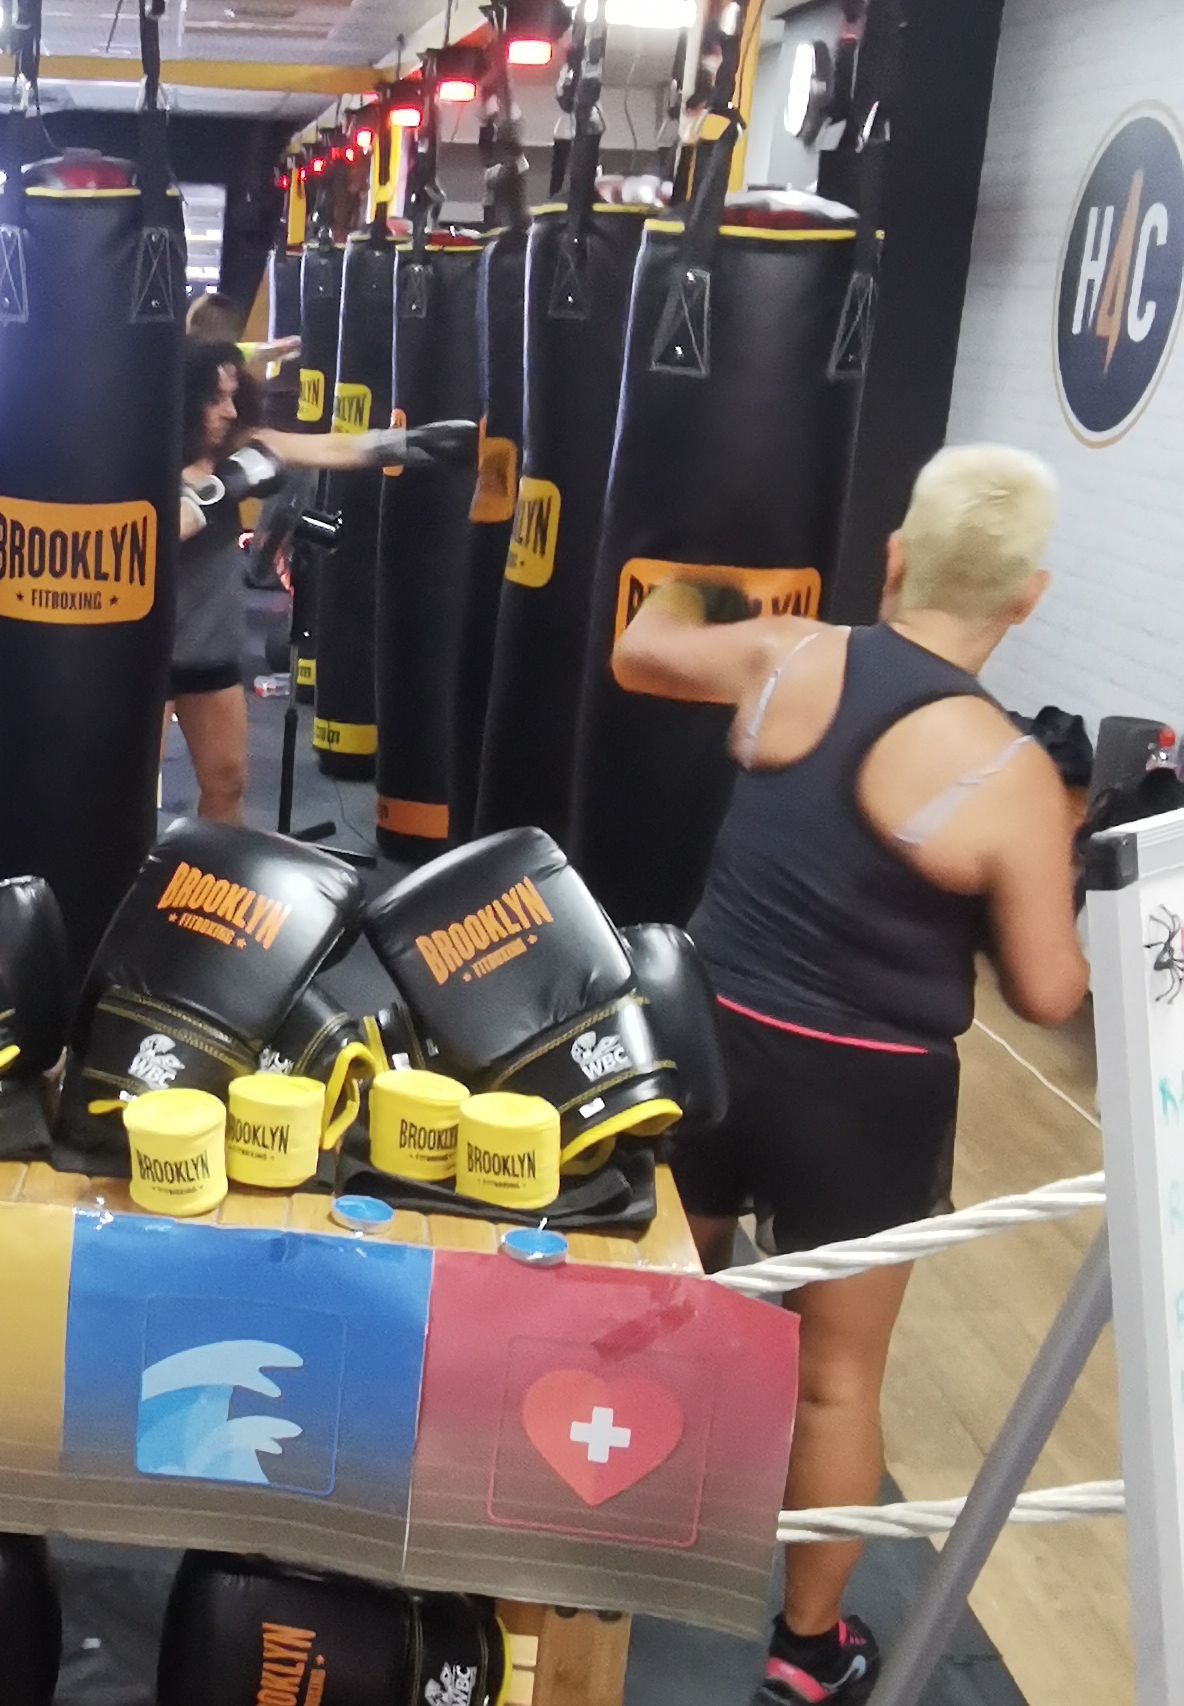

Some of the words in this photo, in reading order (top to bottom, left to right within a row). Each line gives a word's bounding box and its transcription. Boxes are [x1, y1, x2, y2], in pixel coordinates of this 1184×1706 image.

[1071, 169, 1169, 374] H4C
[31, 588, 103, 610] FITBOXING
[157, 861, 293, 950] BROOKLYN
[416, 875, 554, 985] BROOKLYN
[128, 1053, 177, 1089] WBC
[581, 1047, 629, 1082] WBC
[136, 1149, 211, 1183] BROOKLYN
[467, 1141, 536, 1179] BROOKLYN
